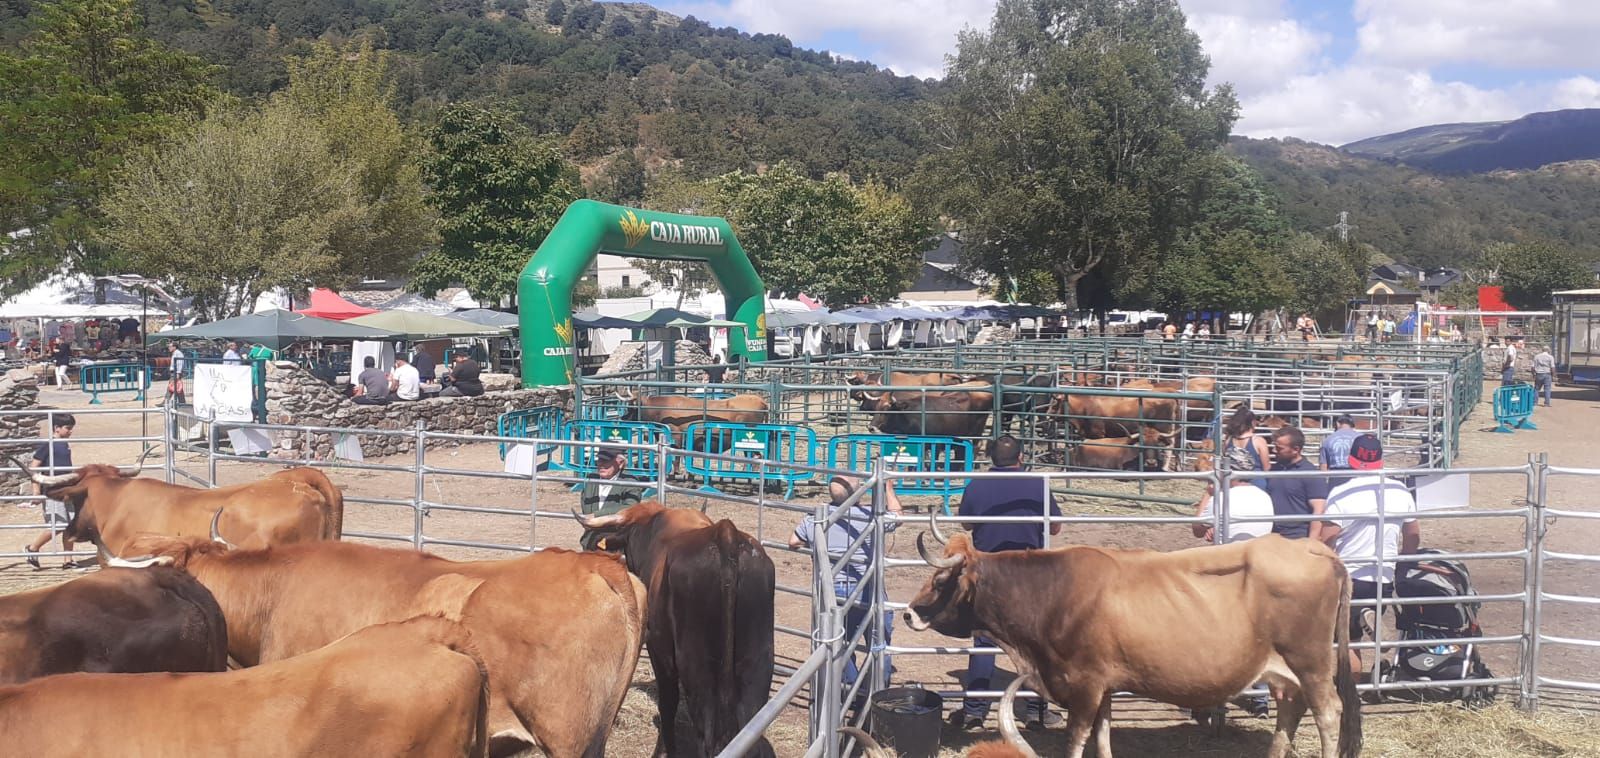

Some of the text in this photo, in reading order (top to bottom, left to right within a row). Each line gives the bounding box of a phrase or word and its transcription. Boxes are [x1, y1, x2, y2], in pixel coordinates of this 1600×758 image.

[650, 221, 724, 245] CAJA RURAL
[544, 347, 565, 356] CAJA
